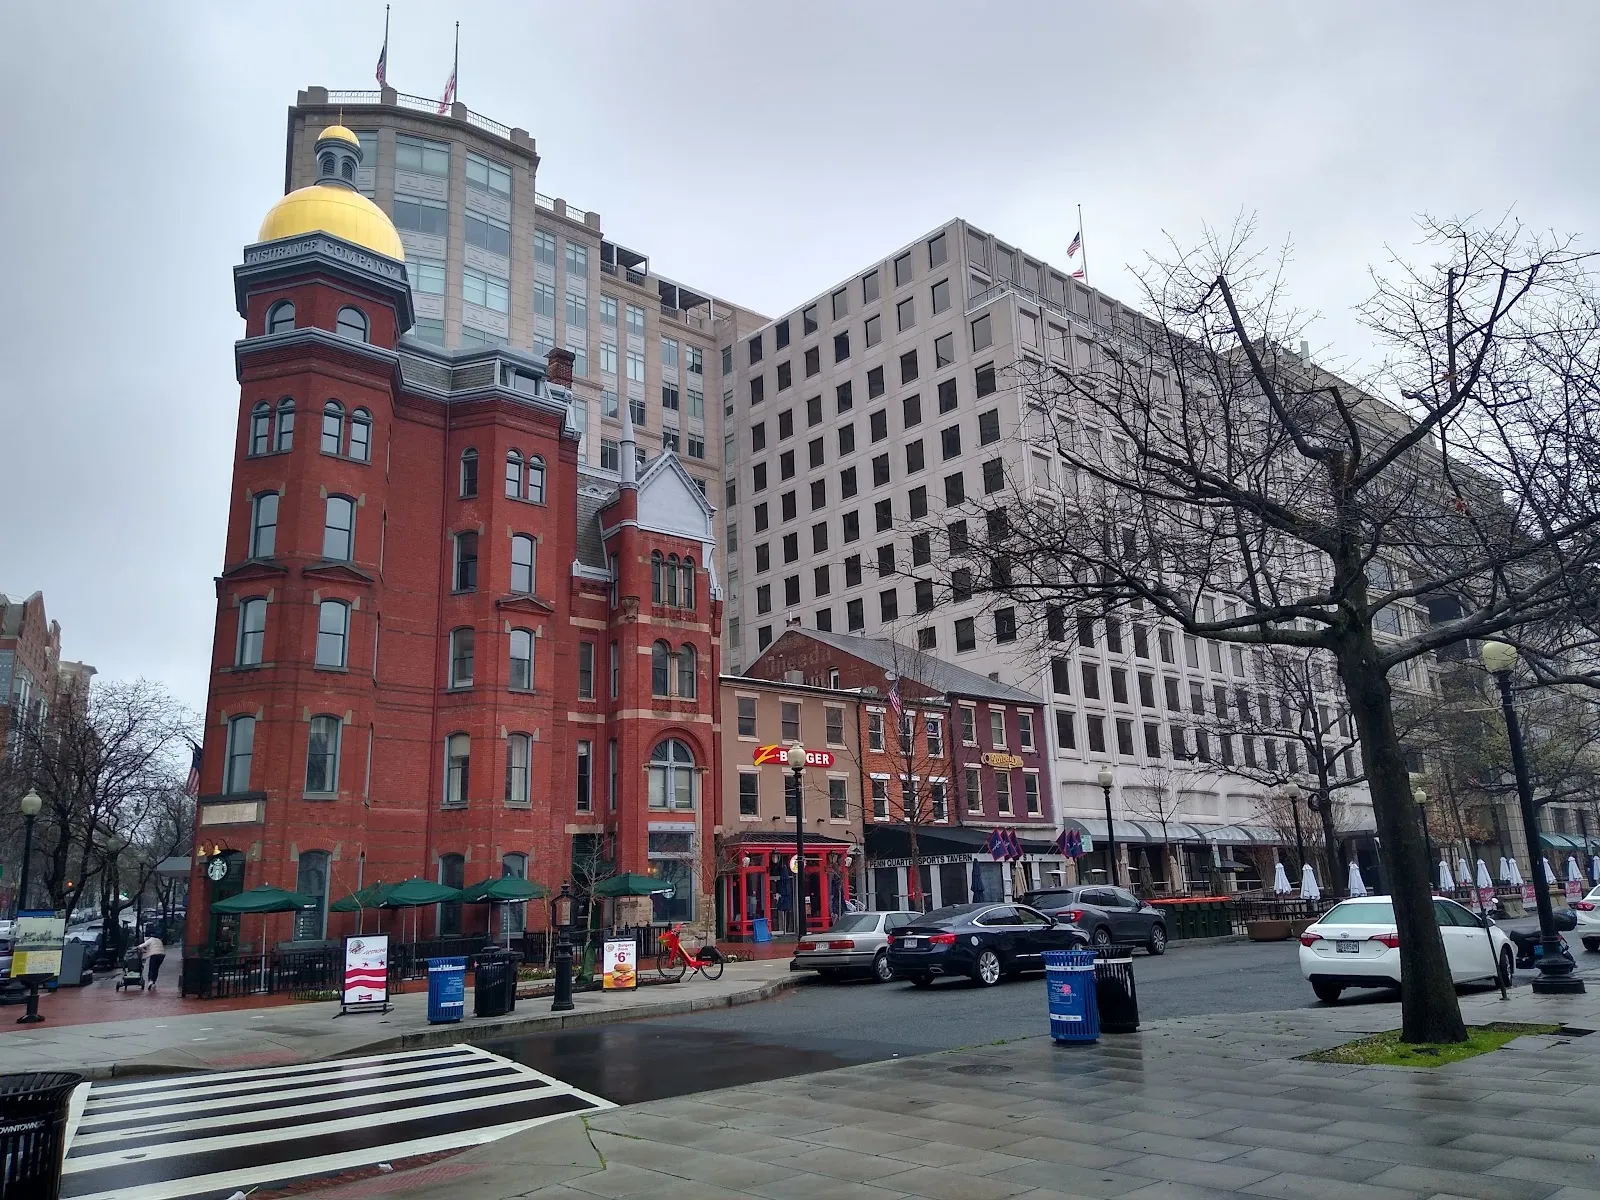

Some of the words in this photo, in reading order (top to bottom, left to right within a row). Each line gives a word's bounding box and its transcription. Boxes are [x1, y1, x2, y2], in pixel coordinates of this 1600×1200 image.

[246, 239, 318, 263] INSURANCE
[324, 241, 397, 276] COMPANY
[753, 744, 830, 766] Z-BGER
[869, 860, 886, 868] PENN
[886, 857, 914, 867] QUARTE
[917, 855, 945, 865] SPORTS
[946, 853, 973, 863] TAVERN
